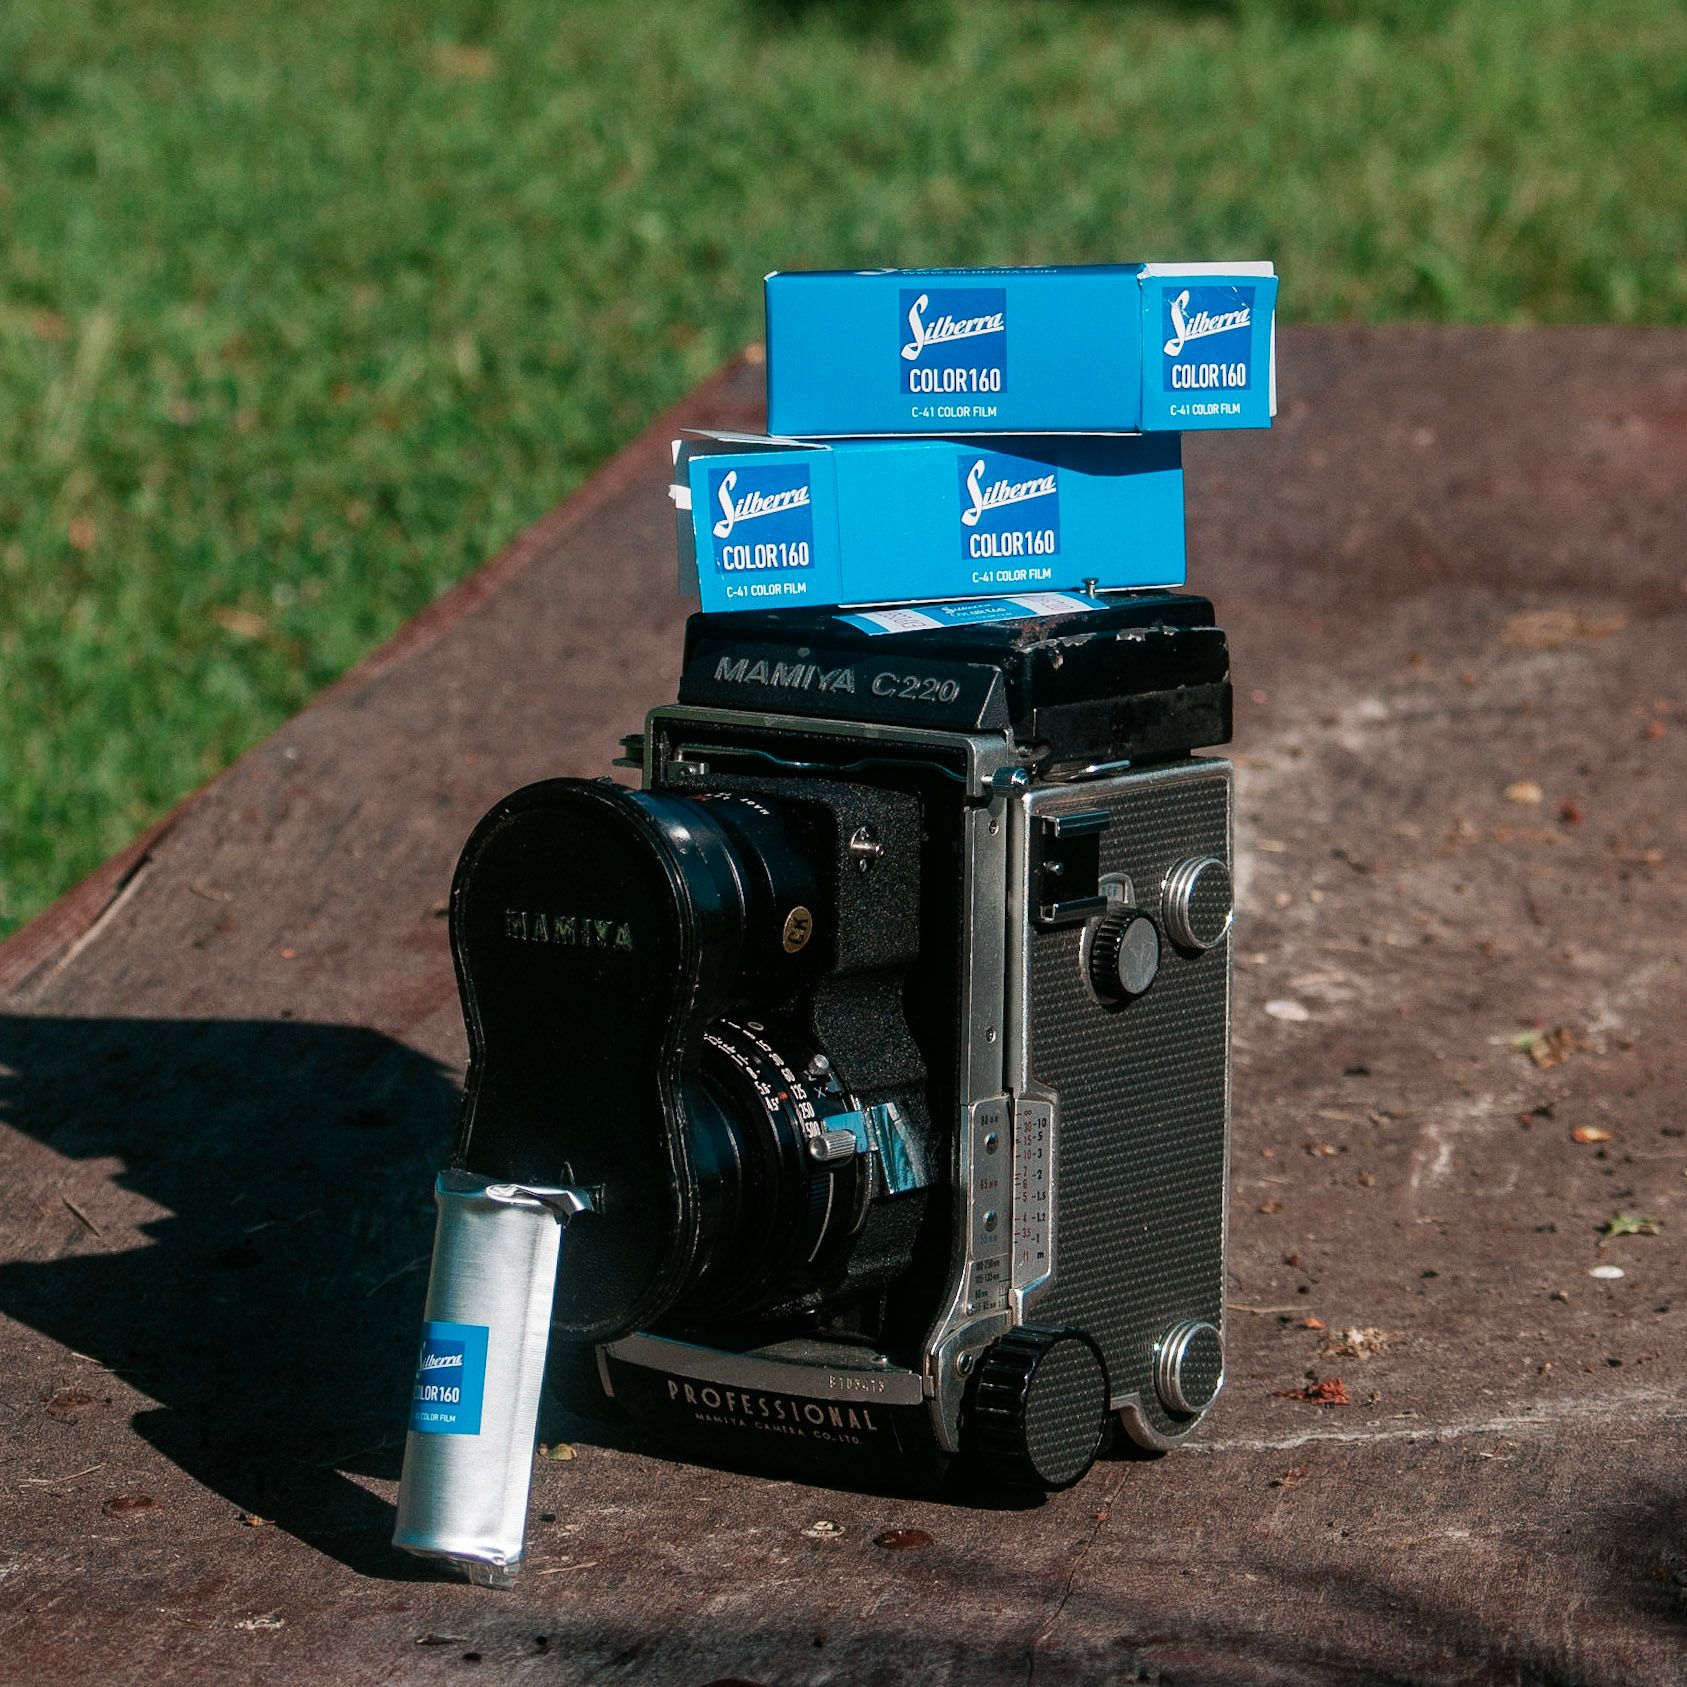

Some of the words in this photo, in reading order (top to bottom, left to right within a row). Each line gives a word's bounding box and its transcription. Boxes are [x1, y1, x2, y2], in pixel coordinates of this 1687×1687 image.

[900, 294, 1004, 361] Silberra
[1163, 289, 1250, 357] Silberra
[909, 368, 1001, 393] COLOR160
[1171, 362, 1246, 389] COLOR160
[911, 406, 935, 418] C-41
[937, 406, 971, 418] COLOR
[973, 406, 997, 417] FILM
[1170, 404, 1190, 416] C-41
[1192, 404, 1219, 416] COLOR
[1220, 403, 1241, 415] FILM
[712, 470, 811, 539] Silberra
[961, 459, 1057, 527] Silberra
[722, 541, 810, 571] COLOR160
[969, 529, 1055, 558] COLOR160
[972, 571, 994, 583] C-41
[996, 570, 1027, 581] COLOR
[1028, 568, 1052, 580] FILM
[726, 586, 748, 598] C-41
[750, 584, 782, 596] COLOR
[783, 582, 807, 594] FILM
[714, 656, 856, 694] MAMIYA
[871, 672, 959, 702] C220
[503, 908, 634, 951] MAMIYA
[789, 1083, 808, 1100] 125
[798, 1101, 816, 1120] 250
[1037, 1117, 1047, 1129] 10
[1037, 1130, 1043, 1141] 5
[1036, 1169, 1043, 1180] 2
[667, 1379, 878, 1431] PROFESSIONAL
[439, 1413, 457, 1424] FILM
